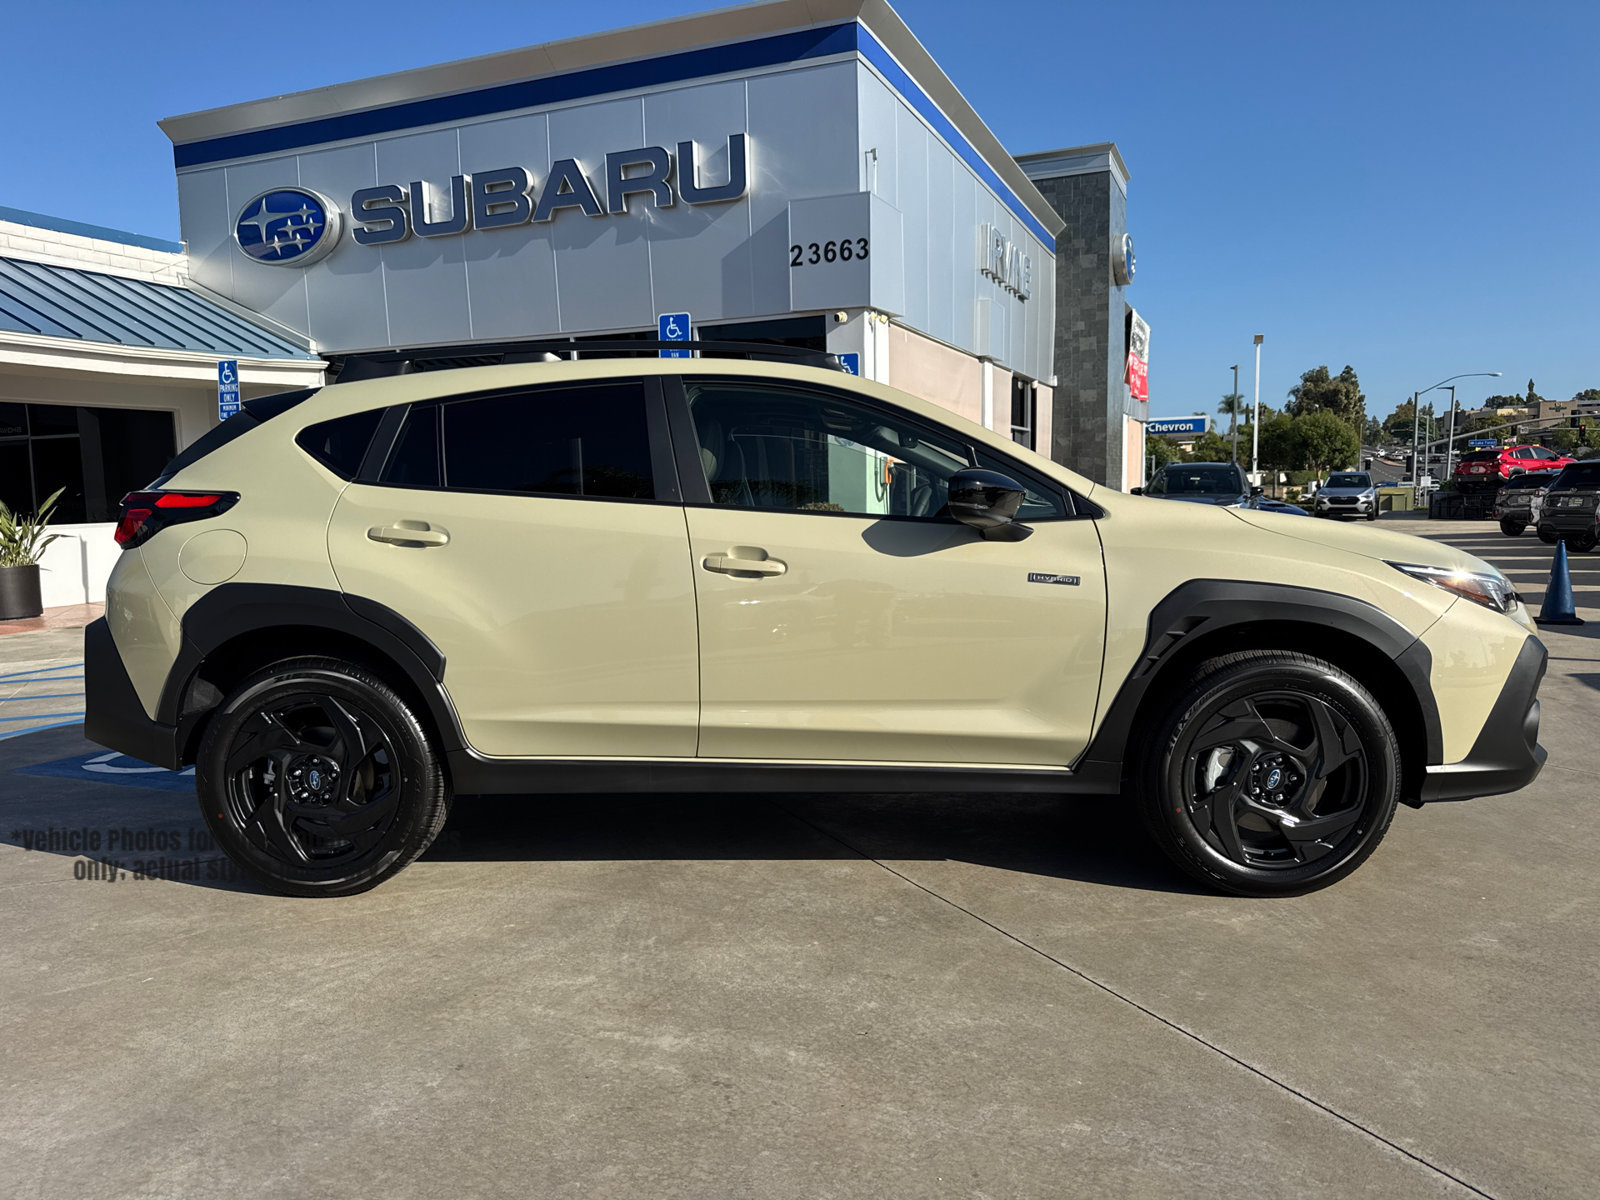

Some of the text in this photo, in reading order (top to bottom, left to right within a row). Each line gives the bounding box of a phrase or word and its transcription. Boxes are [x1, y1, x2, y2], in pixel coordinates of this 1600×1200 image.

[350, 133, 749, 246] SUBARU
[790, 237, 869, 267] 23663
[220, 384, 238, 392] PARKING
[224, 394, 235, 402] ONLY
[1147, 422, 1194, 433] Chevron
[1037, 575, 1073, 583] HYBRID
